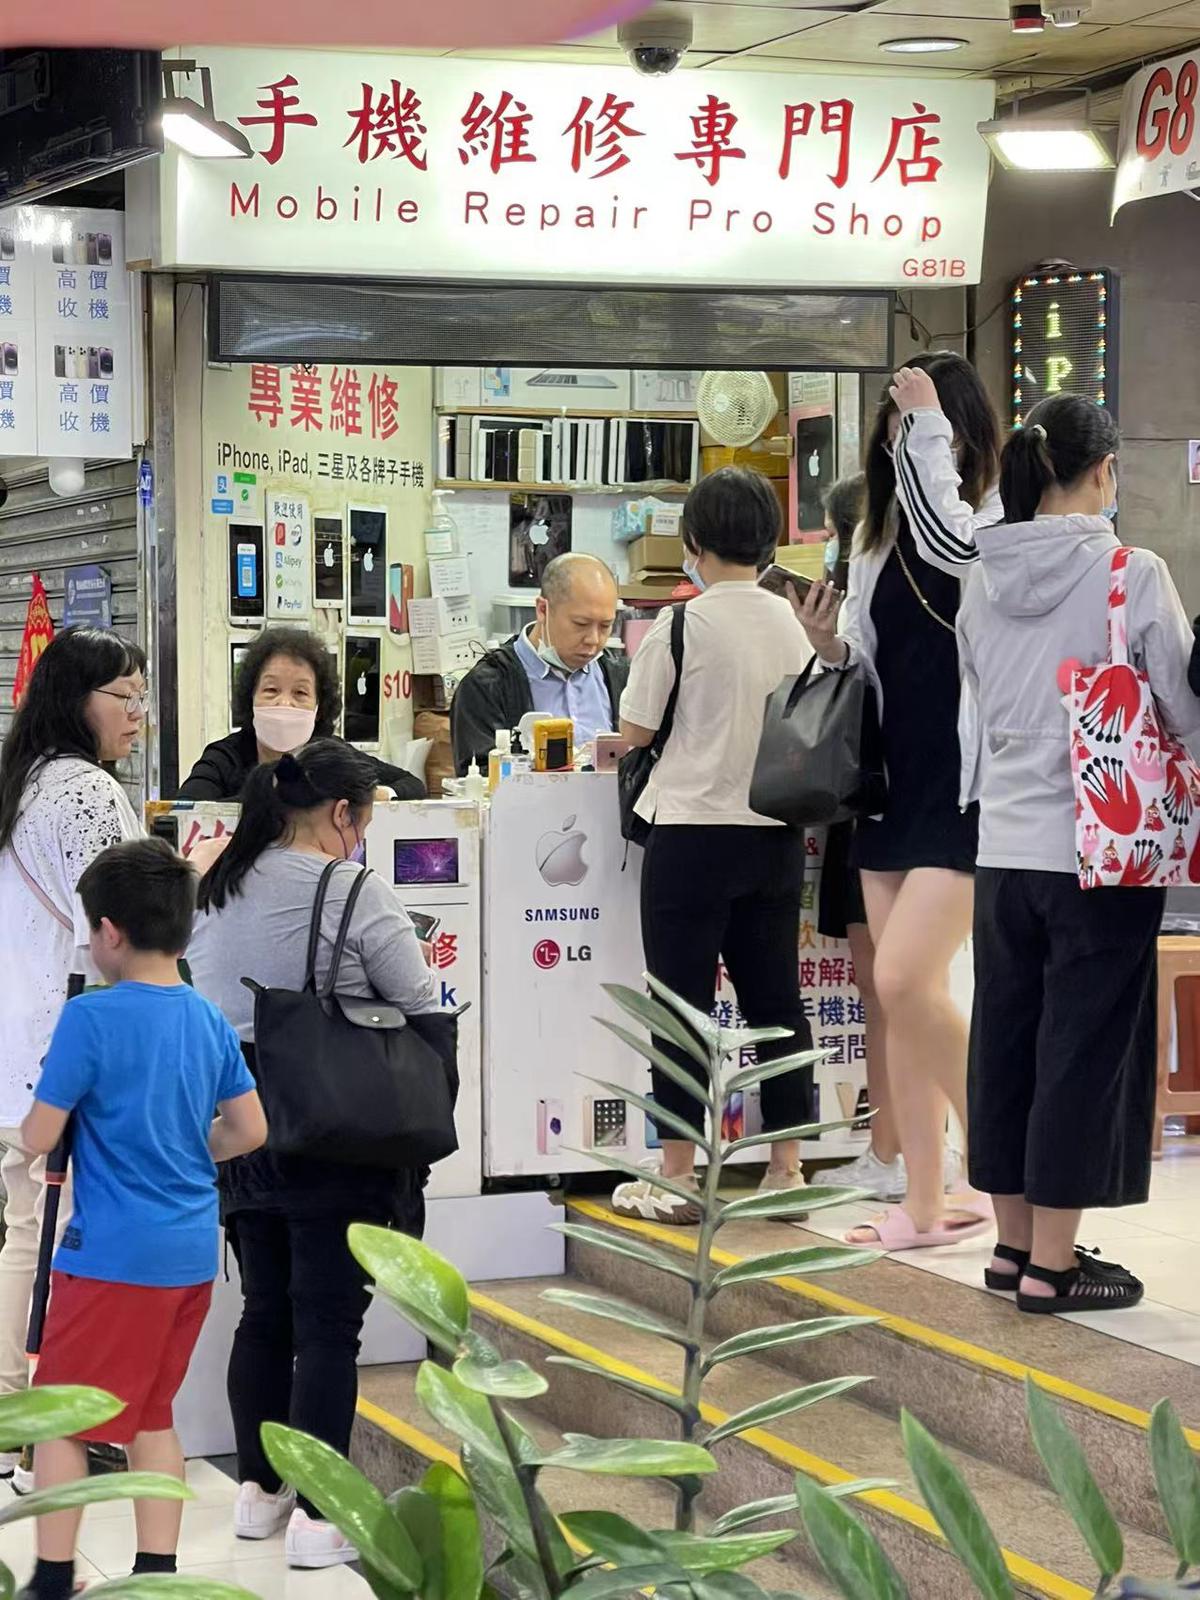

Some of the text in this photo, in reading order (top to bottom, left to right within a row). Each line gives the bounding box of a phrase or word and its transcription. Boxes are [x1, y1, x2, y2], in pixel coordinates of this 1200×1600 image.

[1136, 59, 1199, 162] G8
[236, 74, 943, 189] 手機維修專門店
[230, 181, 942, 242] Mobile Repair Pro Shop
[902, 258, 967, 278] G81B
[57, 269, 109, 291] 高價
[57, 297, 110, 320] 收機
[59, 383, 110, 405] 高價
[247, 363, 400, 441] 專業維修
[59, 410, 111, 433] 收機
[217, 443, 274, 475] iPhone,
[278, 449, 313, 481] iPad,
[317, 453, 425, 488] 三星及各牌子手機
[383, 670, 412, 699] $10
[524, 907, 600, 922] SAMSUNG
[566, 945, 592, 962] LG
